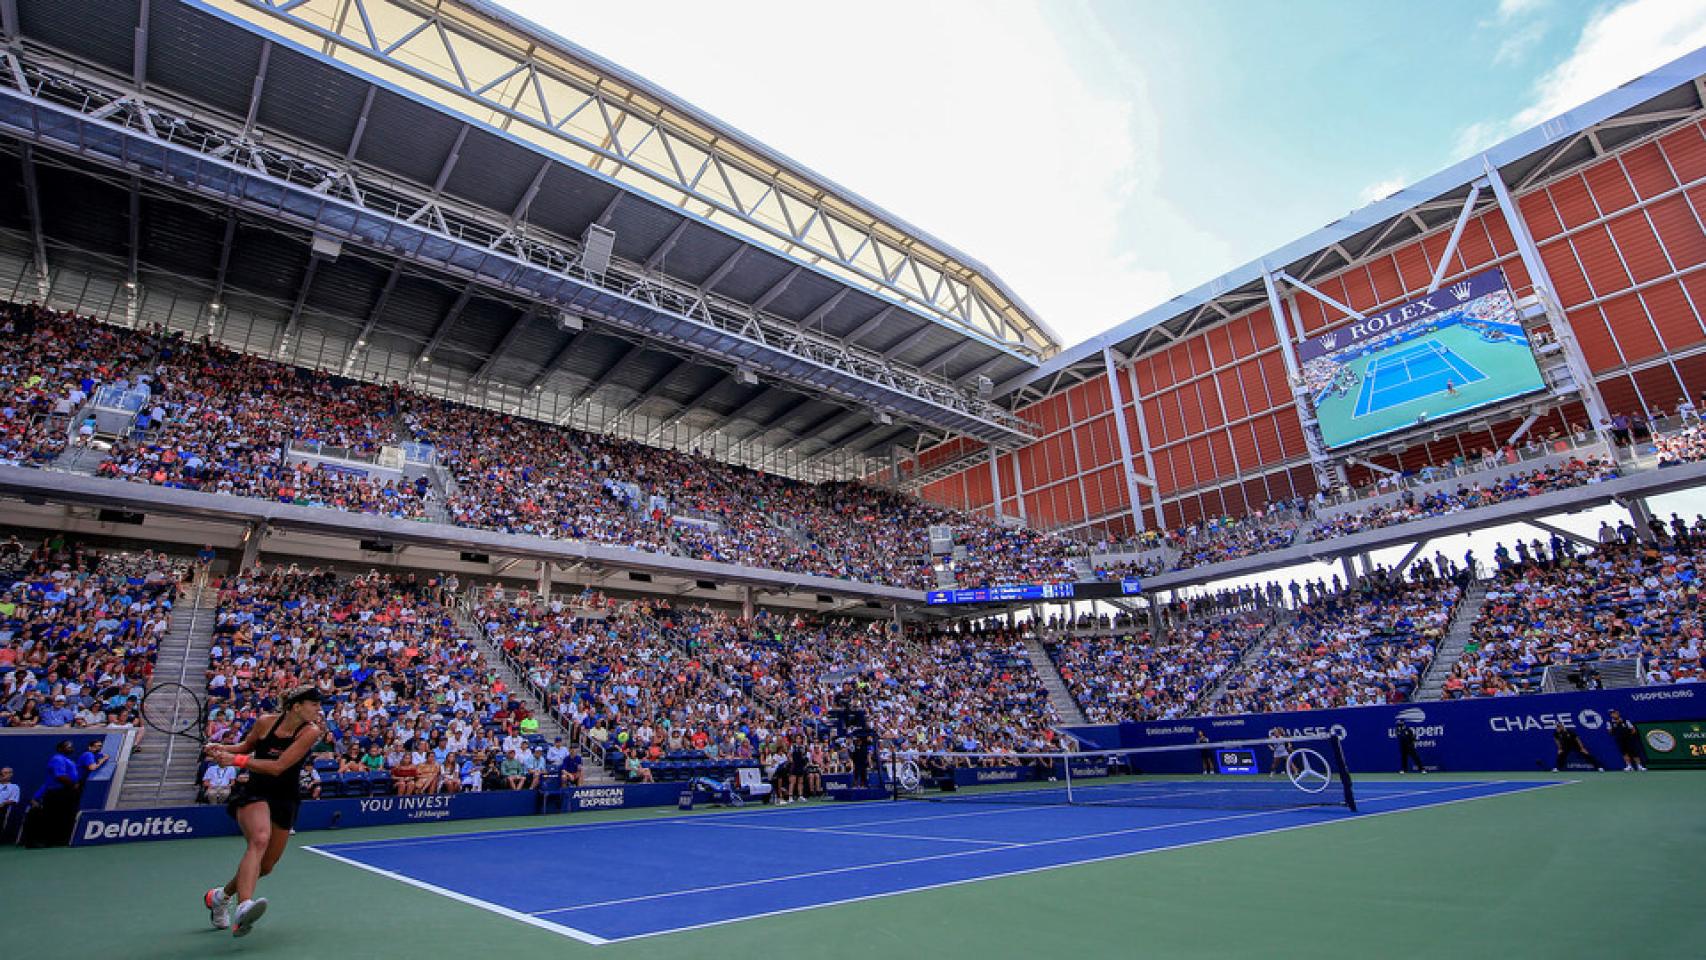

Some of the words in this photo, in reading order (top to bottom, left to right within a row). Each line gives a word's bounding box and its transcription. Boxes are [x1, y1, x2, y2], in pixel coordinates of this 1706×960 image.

[1350, 296, 1436, 340] ROLEX
[1490, 712, 1576, 732] CHASE
[572, 787, 624, 799] AMERICAN
[579, 797, 624, 808] EXPRESS
[360, 798, 394, 813] YOU
[398, 795, 451, 810] INVEST
[83, 816, 194, 841] Deloitte.
